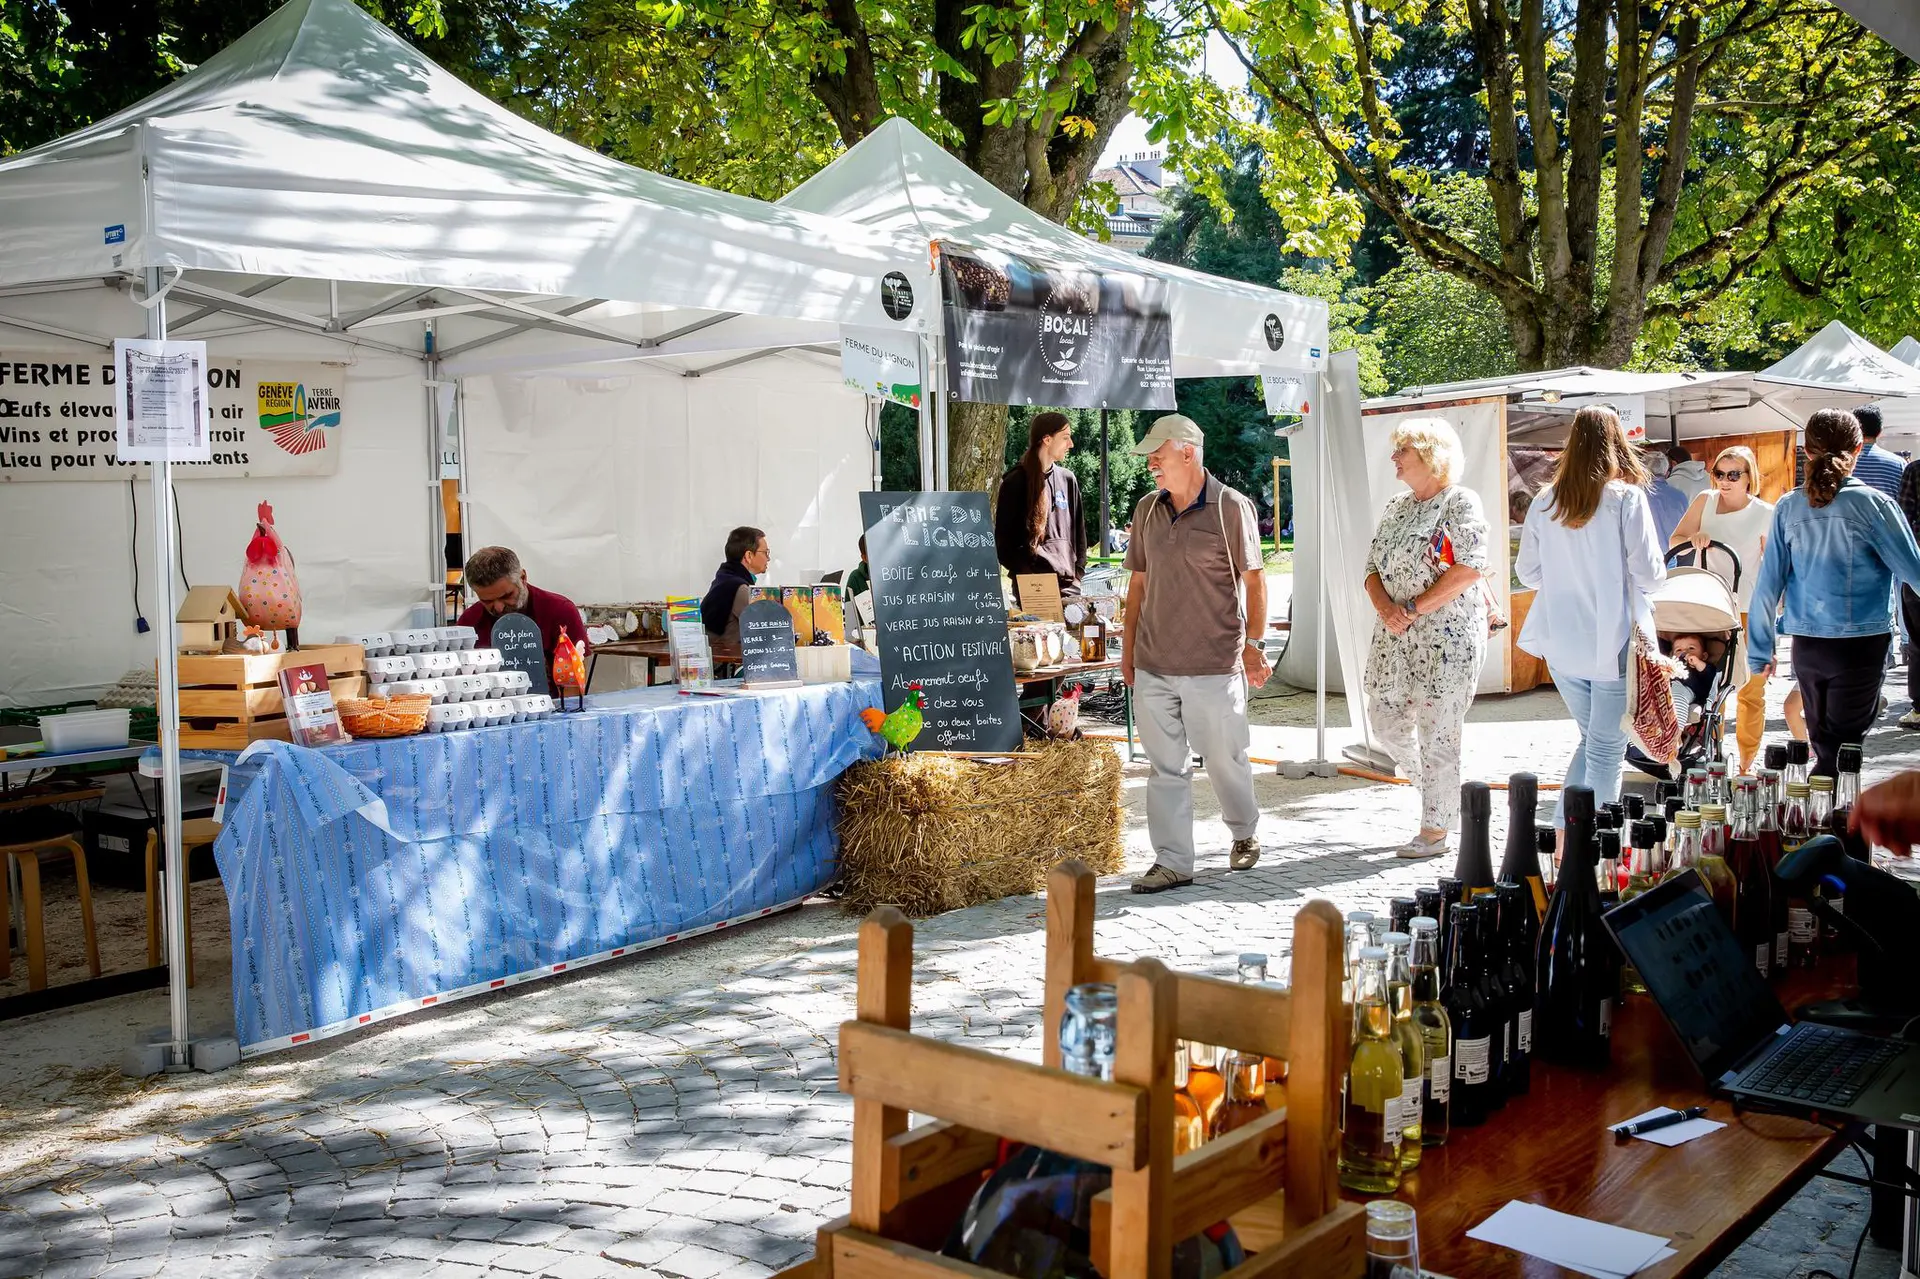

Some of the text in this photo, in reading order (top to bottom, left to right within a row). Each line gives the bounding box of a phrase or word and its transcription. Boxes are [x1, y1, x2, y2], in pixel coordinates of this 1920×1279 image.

[1044, 315, 1088, 336] BOCAL
[1059, 335, 1075, 344] local
[845, 338, 870, 354] FERME
[872, 347, 883, 358] DU
[0, 363, 116, 387] FERME D
[258, 383, 293, 398] GENÈVE
[312, 388, 332, 397] TERRE
[308, 397, 340, 410] AVENIR
[221, 404, 243, 418] air
[0, 426, 41, 443] Vins
[49, 428, 68, 443] et
[209, 428, 245, 442] rroir
[0, 452, 42, 467] Lieu
[51, 455, 96, 471] pour
[880, 504, 982, 524] FERME DU
[921, 566, 928, 579] 6
[882, 595, 902, 606] JUS
[907, 594, 917, 605] DE
[885, 619, 918, 632] VERRE
[923, 618, 940, 628] JUS
[934, 696, 957, 708] chez
[962, 697, 985, 708] vous
[951, 717, 972, 727] deux
